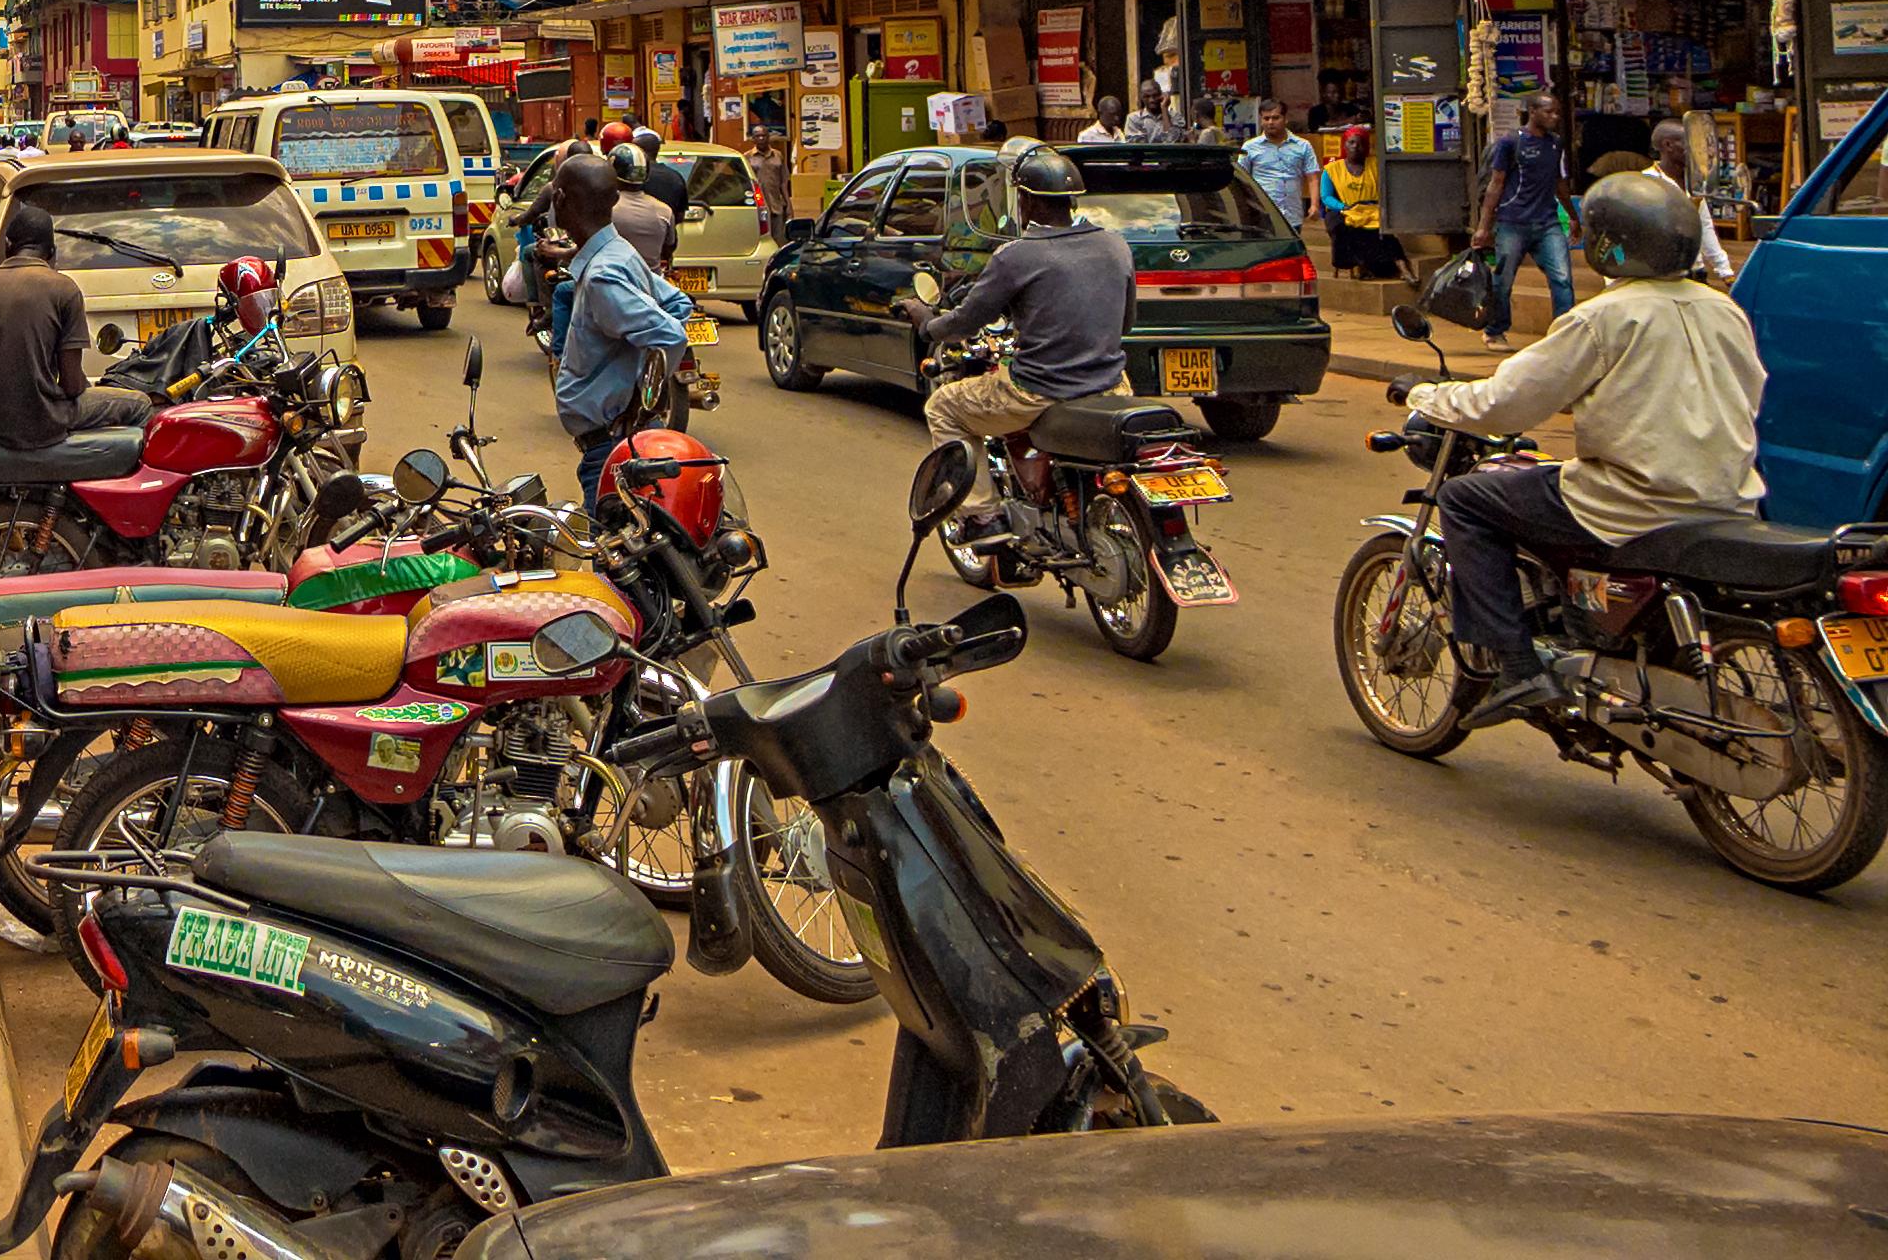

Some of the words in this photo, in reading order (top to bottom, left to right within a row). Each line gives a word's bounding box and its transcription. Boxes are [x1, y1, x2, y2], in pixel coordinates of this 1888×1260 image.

[718, 10, 738, 26] STAR
[740, 9, 779, 25] GRAPHICS
[340, 224, 362, 237] UAT
[364, 223, 391, 236] 095J
[408, 217, 443, 232] 095J
[1179, 350, 1211, 370] UAR
[1170, 370, 1211, 390] 554W
